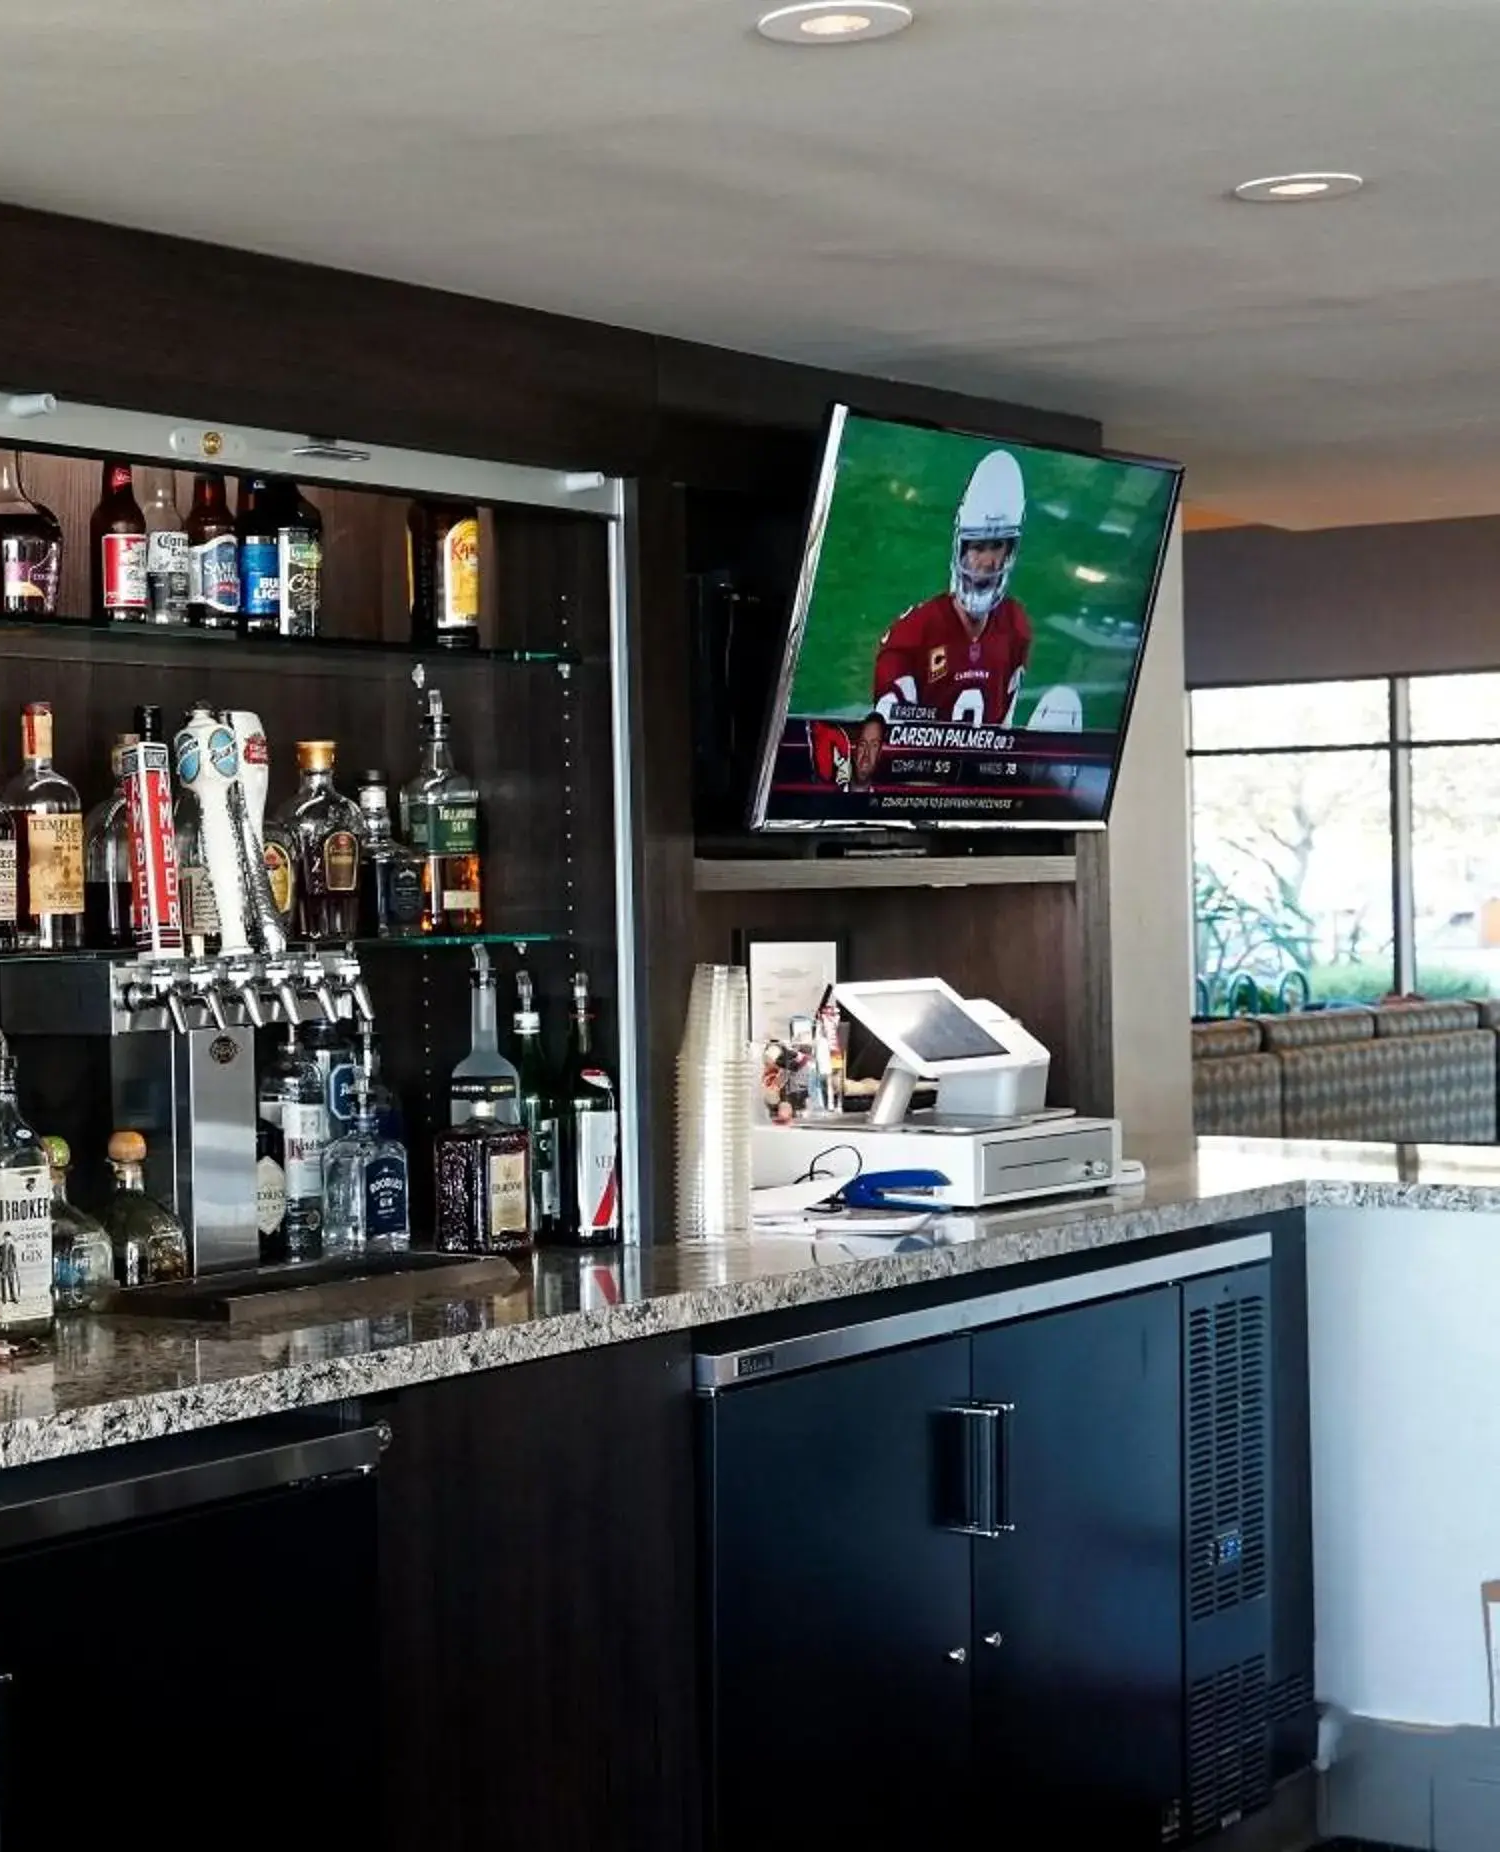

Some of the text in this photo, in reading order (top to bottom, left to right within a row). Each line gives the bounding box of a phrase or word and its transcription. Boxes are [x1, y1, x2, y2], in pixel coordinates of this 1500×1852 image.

[889, 726, 944, 746] CARSON
[944, 729, 994, 749] PALMER
[157, 772, 181, 928] AMBER
